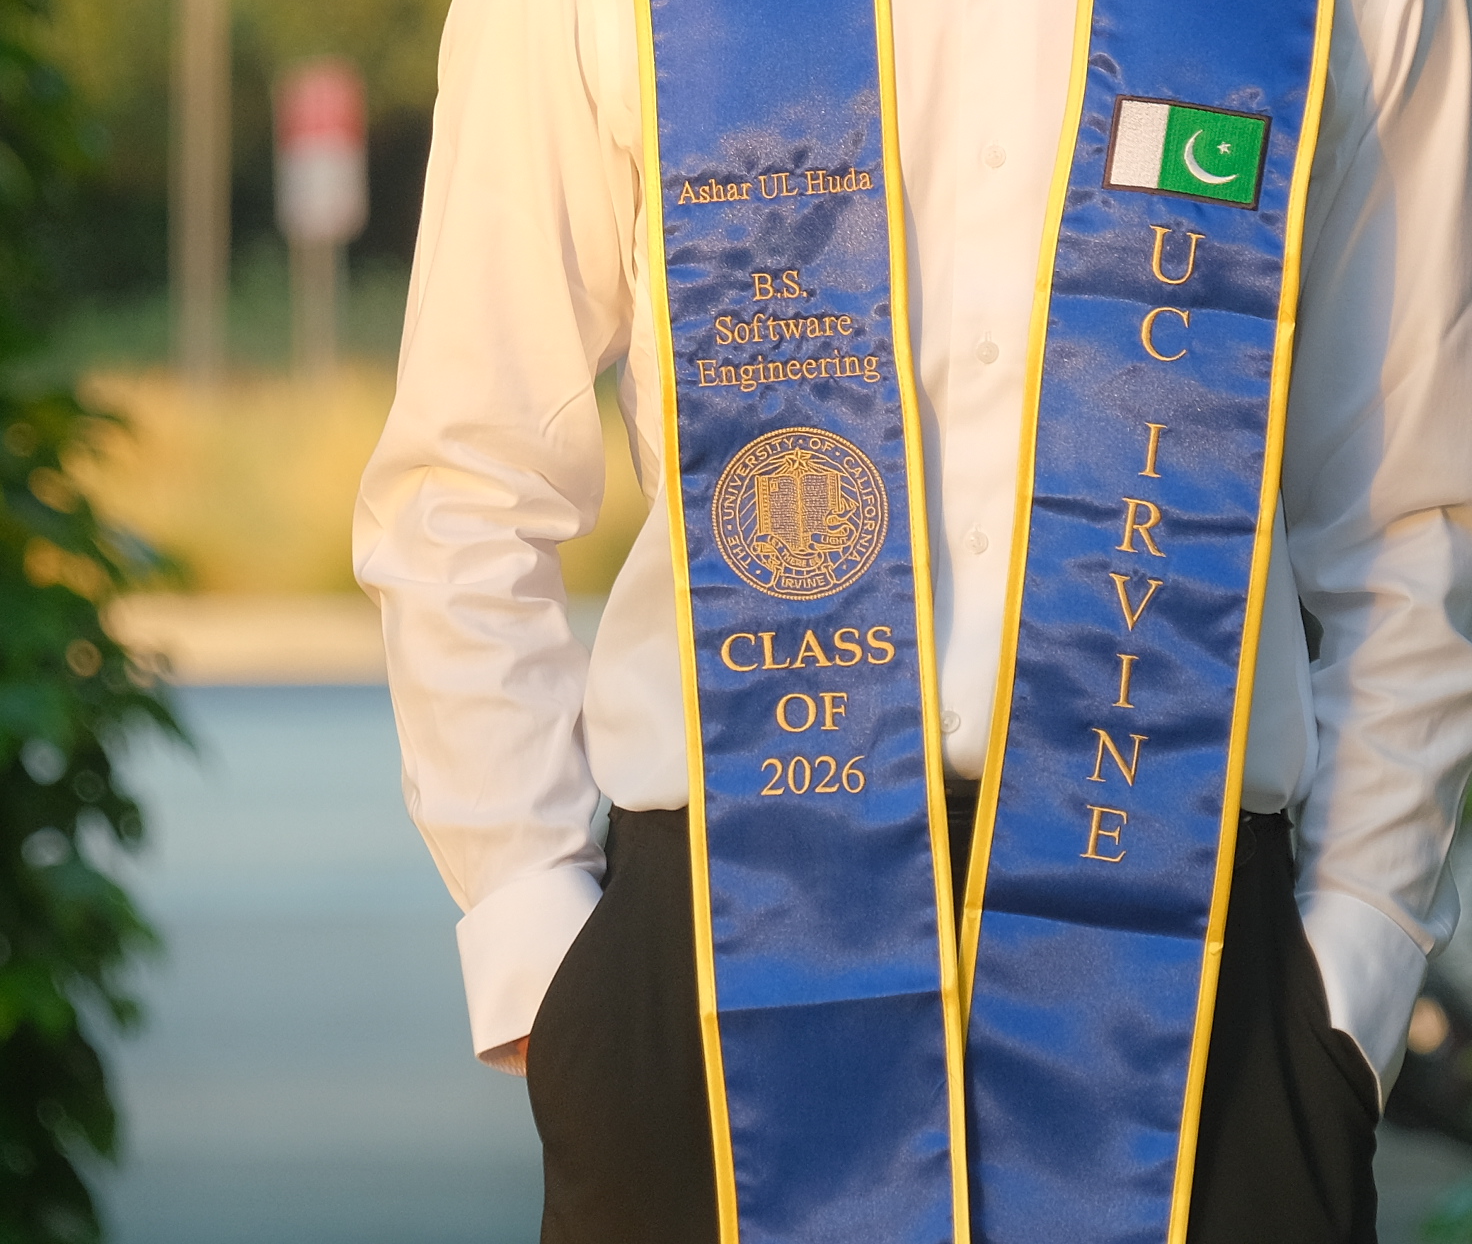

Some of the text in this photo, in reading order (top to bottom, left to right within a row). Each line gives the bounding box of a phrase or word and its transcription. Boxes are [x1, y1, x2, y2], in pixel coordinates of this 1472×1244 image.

[678, 168, 874, 205] Ashar UL Huda
[751, 270, 807, 301] B.S.
[715, 313, 853, 345] Software
[697, 349, 881, 392] Engineering
[723, 437, 876, 568] THE UNIVERSITY OF CALIFORNIA
[781, 575, 826, 588] IRVINE
[721, 626, 895, 671] CLASS
[1080, 422, 1168, 863] IRVINE
[776, 692, 848, 732] OF
[760, 756, 866, 796] 2026
